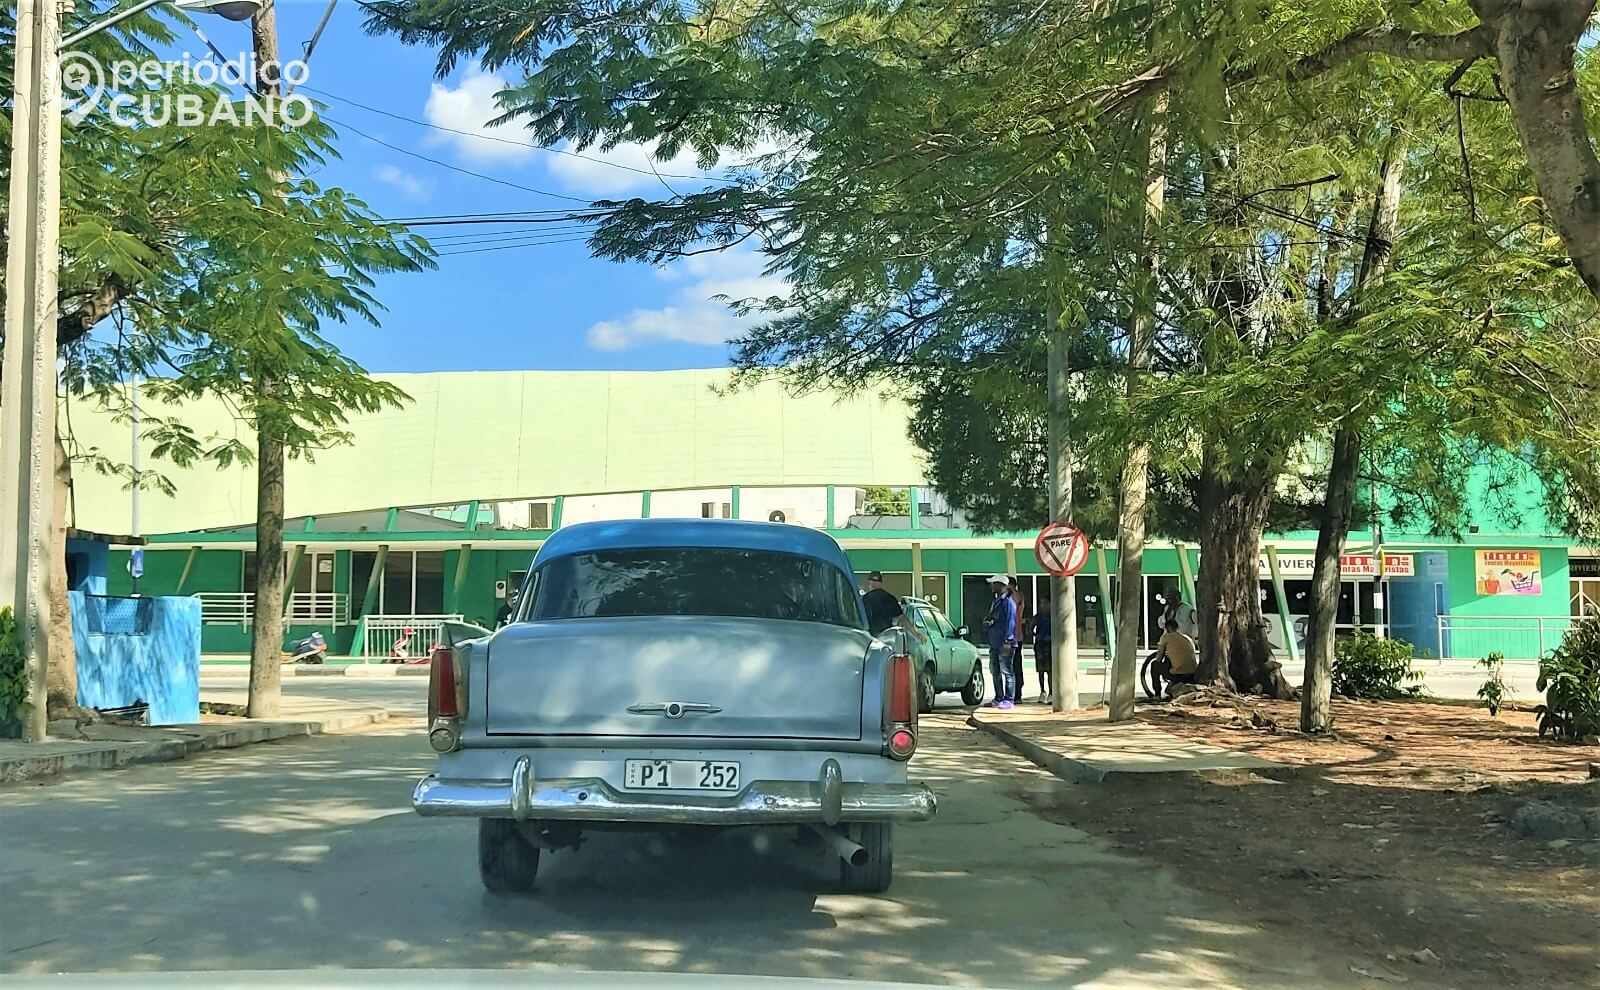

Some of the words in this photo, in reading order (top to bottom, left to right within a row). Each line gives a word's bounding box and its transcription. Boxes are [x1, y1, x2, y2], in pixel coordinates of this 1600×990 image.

[1051, 539, 1071, 548] PARE
[1269, 559, 1315, 569] IVIER
[1363, 565, 1409, 573] Maristas
[641, 765, 669, 787] P1
[700, 765, 737, 788] 252
